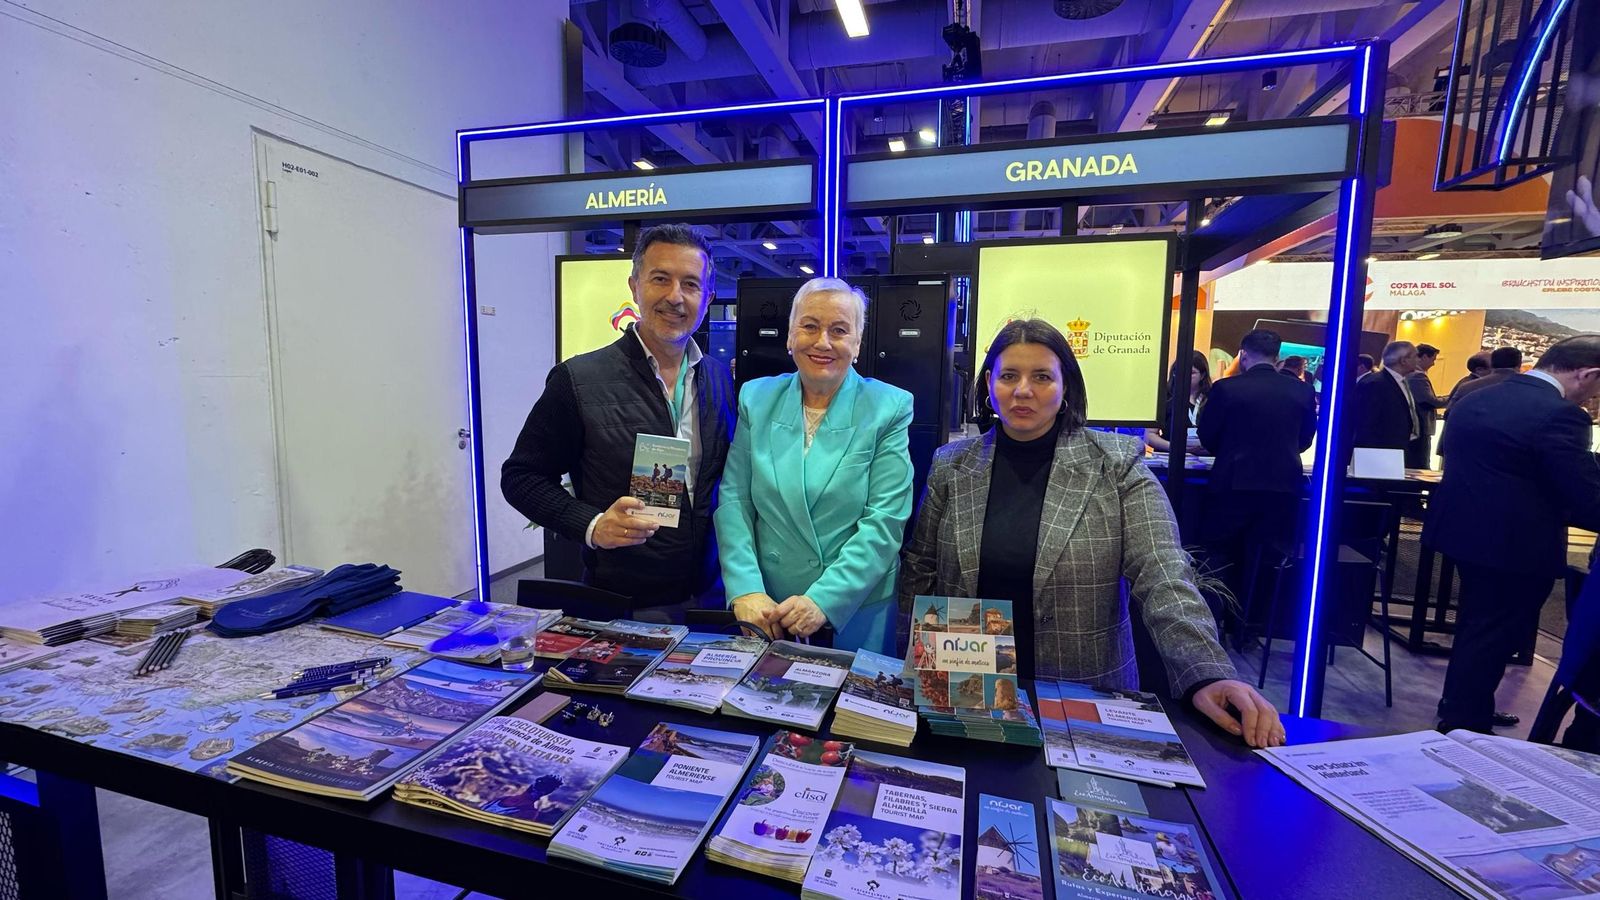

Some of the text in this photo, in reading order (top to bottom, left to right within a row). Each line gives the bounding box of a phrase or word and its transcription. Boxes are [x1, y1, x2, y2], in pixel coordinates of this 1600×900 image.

[281, 162, 319, 178] H02-E01-002
[1005, 153, 1138, 182] GRANADA
[585, 183, 668, 210] ALMERÍA
[1094, 331, 1151, 344] Diputación
[1093, 344, 1151, 354] de Granada
[795, 668, 832, 677] ALMANZORA
[1104, 708, 1137, 717] LEVANTE
[1106, 713, 1153, 724] ALMERIENSE
[494, 724, 532, 741] Provincia
[531, 737, 543, 746] de
[542, 742, 576, 756] Almería
[510, 720, 572, 747] CICLOTURISTA
[505, 738, 521, 749] EN
[520, 744, 534, 754] 13
[531, 748, 574, 765] ETAPAS
[672, 762, 710, 775] PONIENTE
[1307, 763, 1327, 771] Der
[1323, 762, 1357, 770] Schatz
[665, 774, 689, 782] TOURIST
[668, 768, 718, 782] ALMERIENSE
[1318, 768, 1370, 780] Hinterland
[794, 787, 828, 802] clisol
[885, 789, 927, 803] TABERNAS,
[881, 801, 927, 815] ALHAMILLA
[883, 795, 920, 807] FILABRES
[928, 804, 958, 815] SIERRA
[880, 807, 908, 818] TOURIST
[1061, 879, 1085, 891] Rutas
